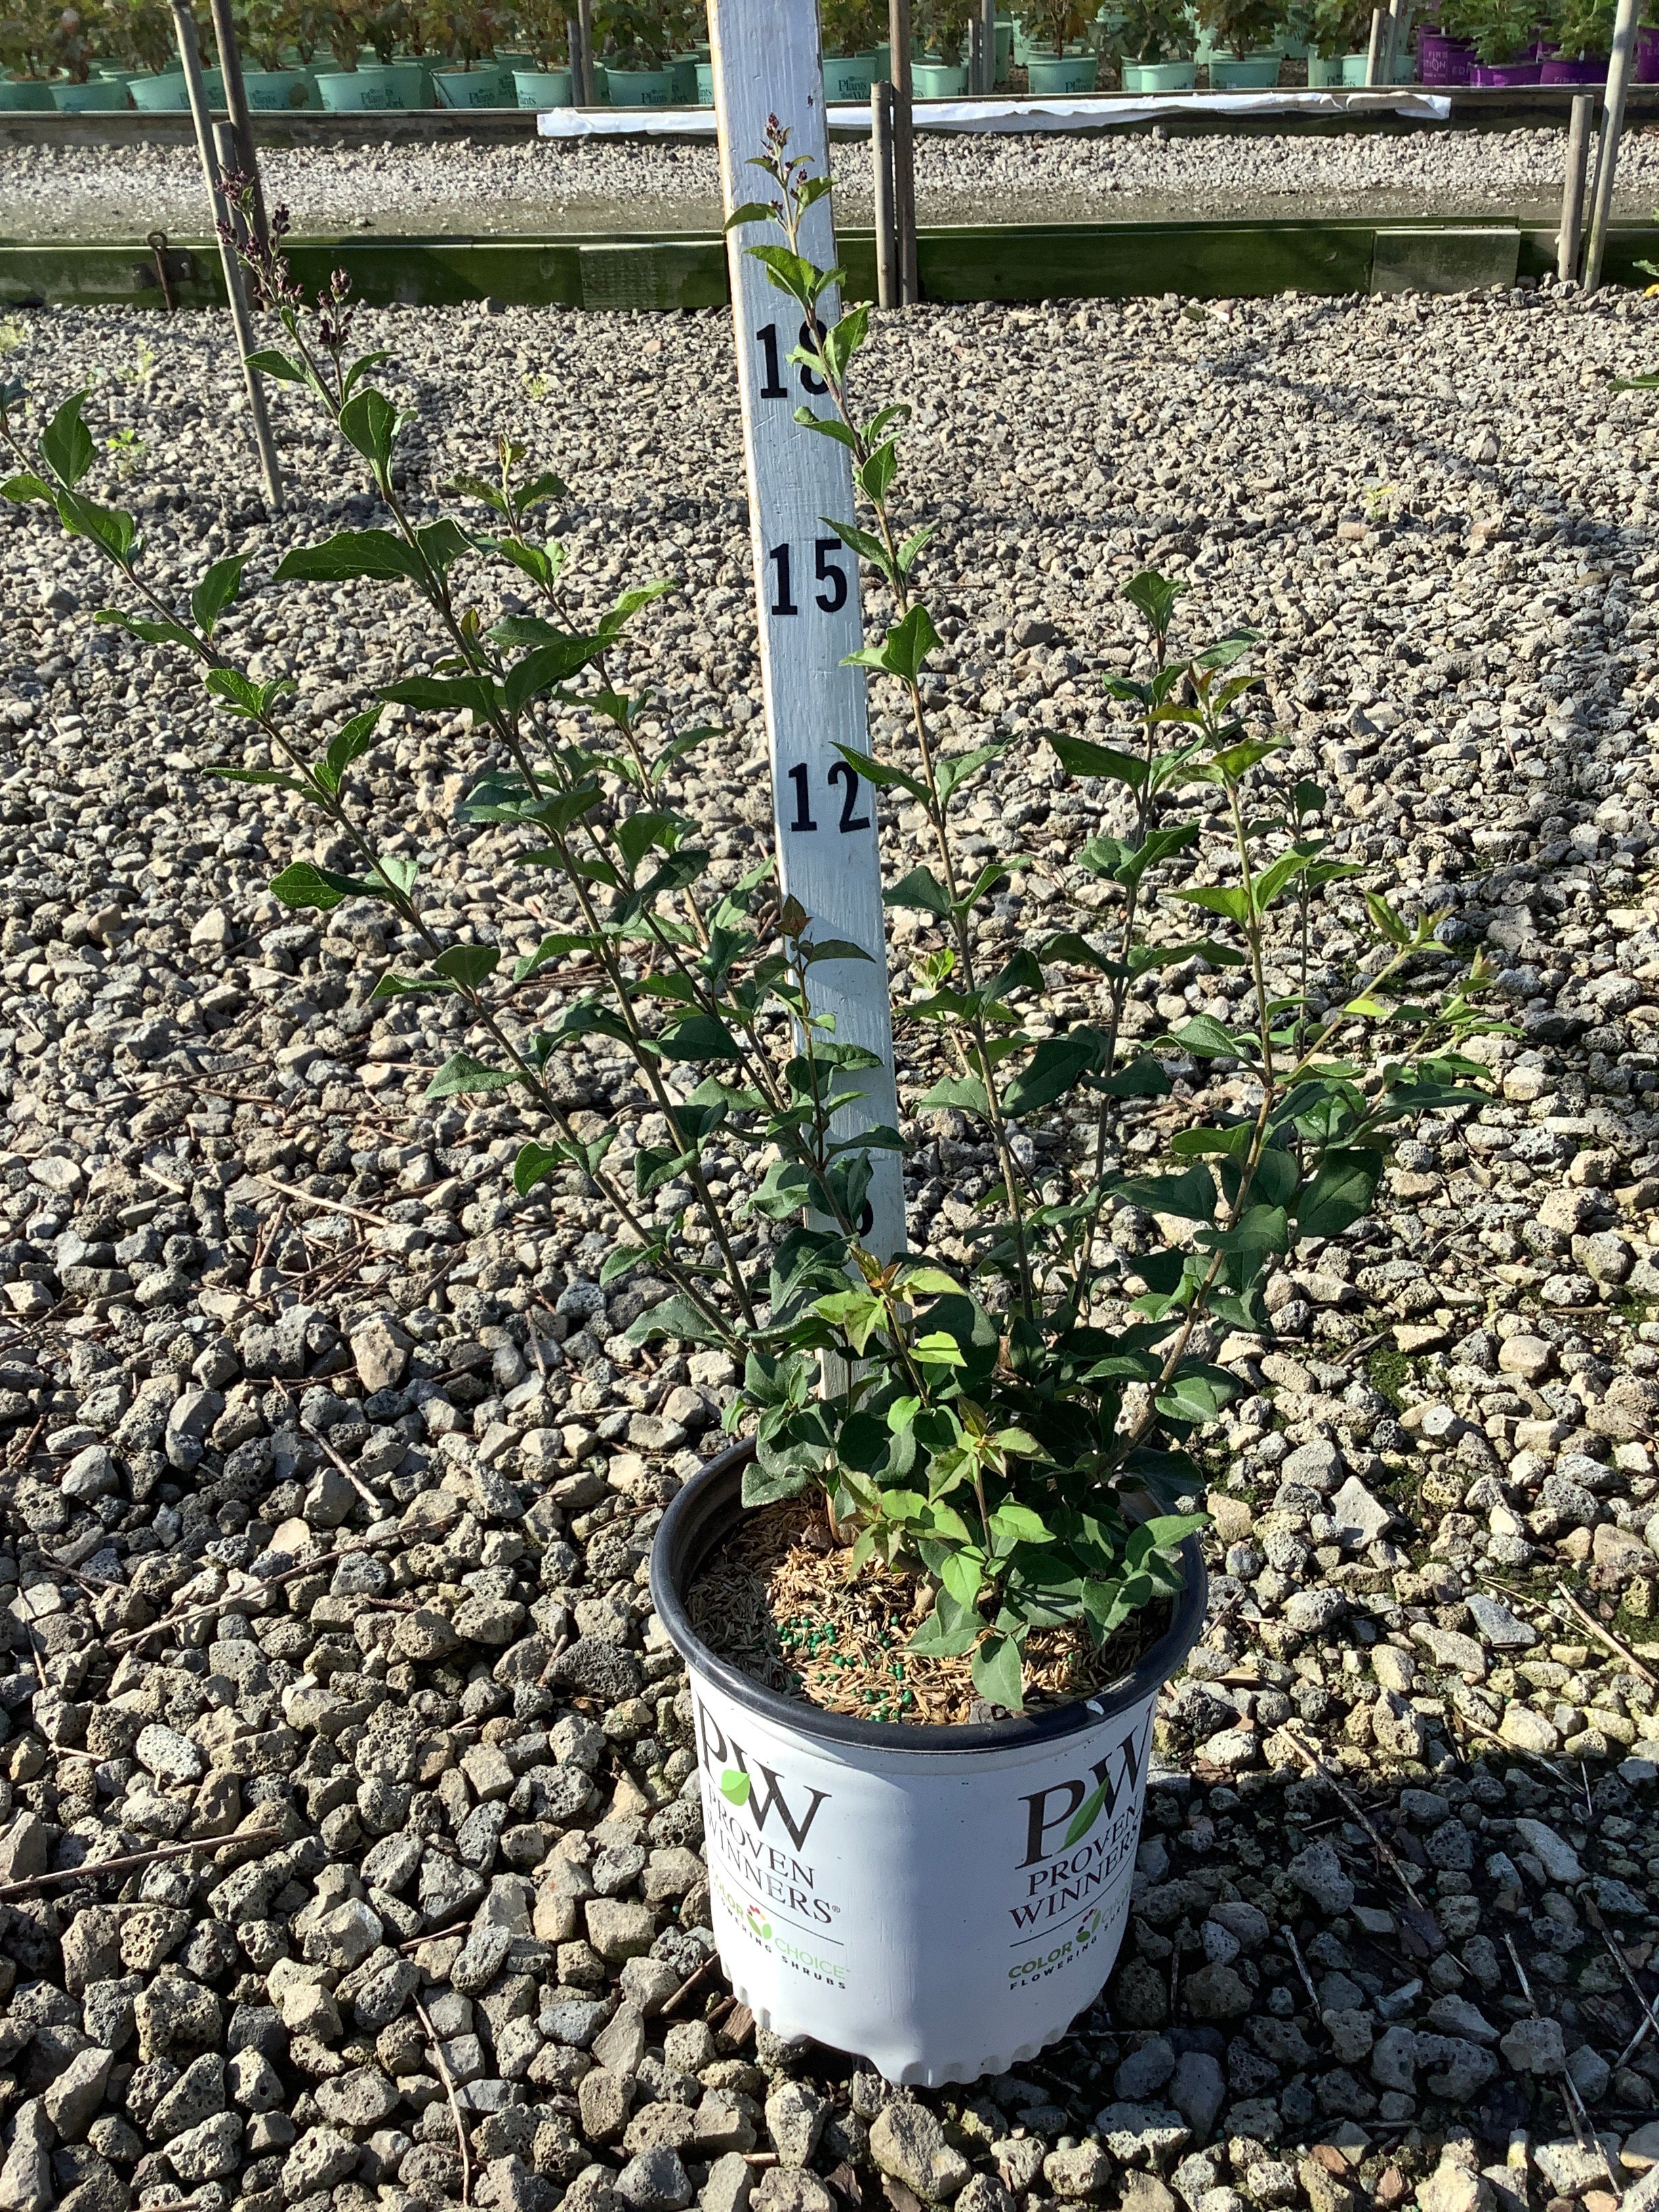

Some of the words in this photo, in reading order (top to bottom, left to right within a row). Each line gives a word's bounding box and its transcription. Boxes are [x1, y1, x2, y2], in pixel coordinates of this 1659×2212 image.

[756, 319, 828, 398] 18
[770, 538, 847, 615] 15
[788, 760, 871, 834] 12
[1015, 1698, 1153, 1870] PW
[708, 1782, 815, 1889] PROVEN
[1026, 1790, 1139, 1897] PROVEN
[781, 1955, 846, 1990] SHRUBS
[1008, 1940, 1073, 1980] COLOR
[1010, 1935, 1097, 1990] FLOWERING
